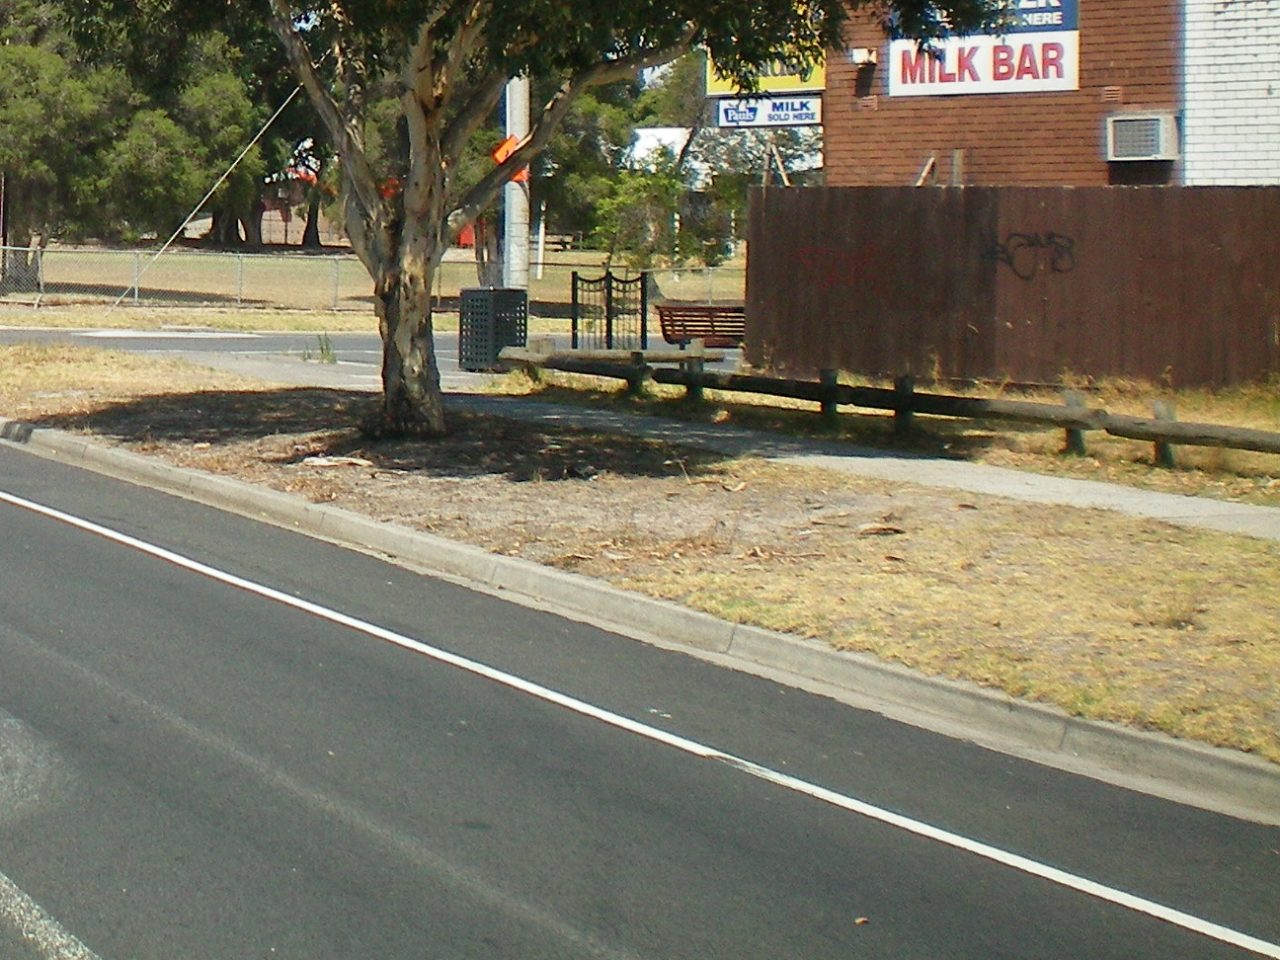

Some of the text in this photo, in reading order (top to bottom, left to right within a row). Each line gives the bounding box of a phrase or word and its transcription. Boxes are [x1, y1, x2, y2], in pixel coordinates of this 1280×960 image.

[901, 41, 1065, 84] MILK BAR
[771, 100, 811, 112] MILK
[726, 108, 755, 121] Pauls
[767, 111, 817, 122] SOLD HERE
